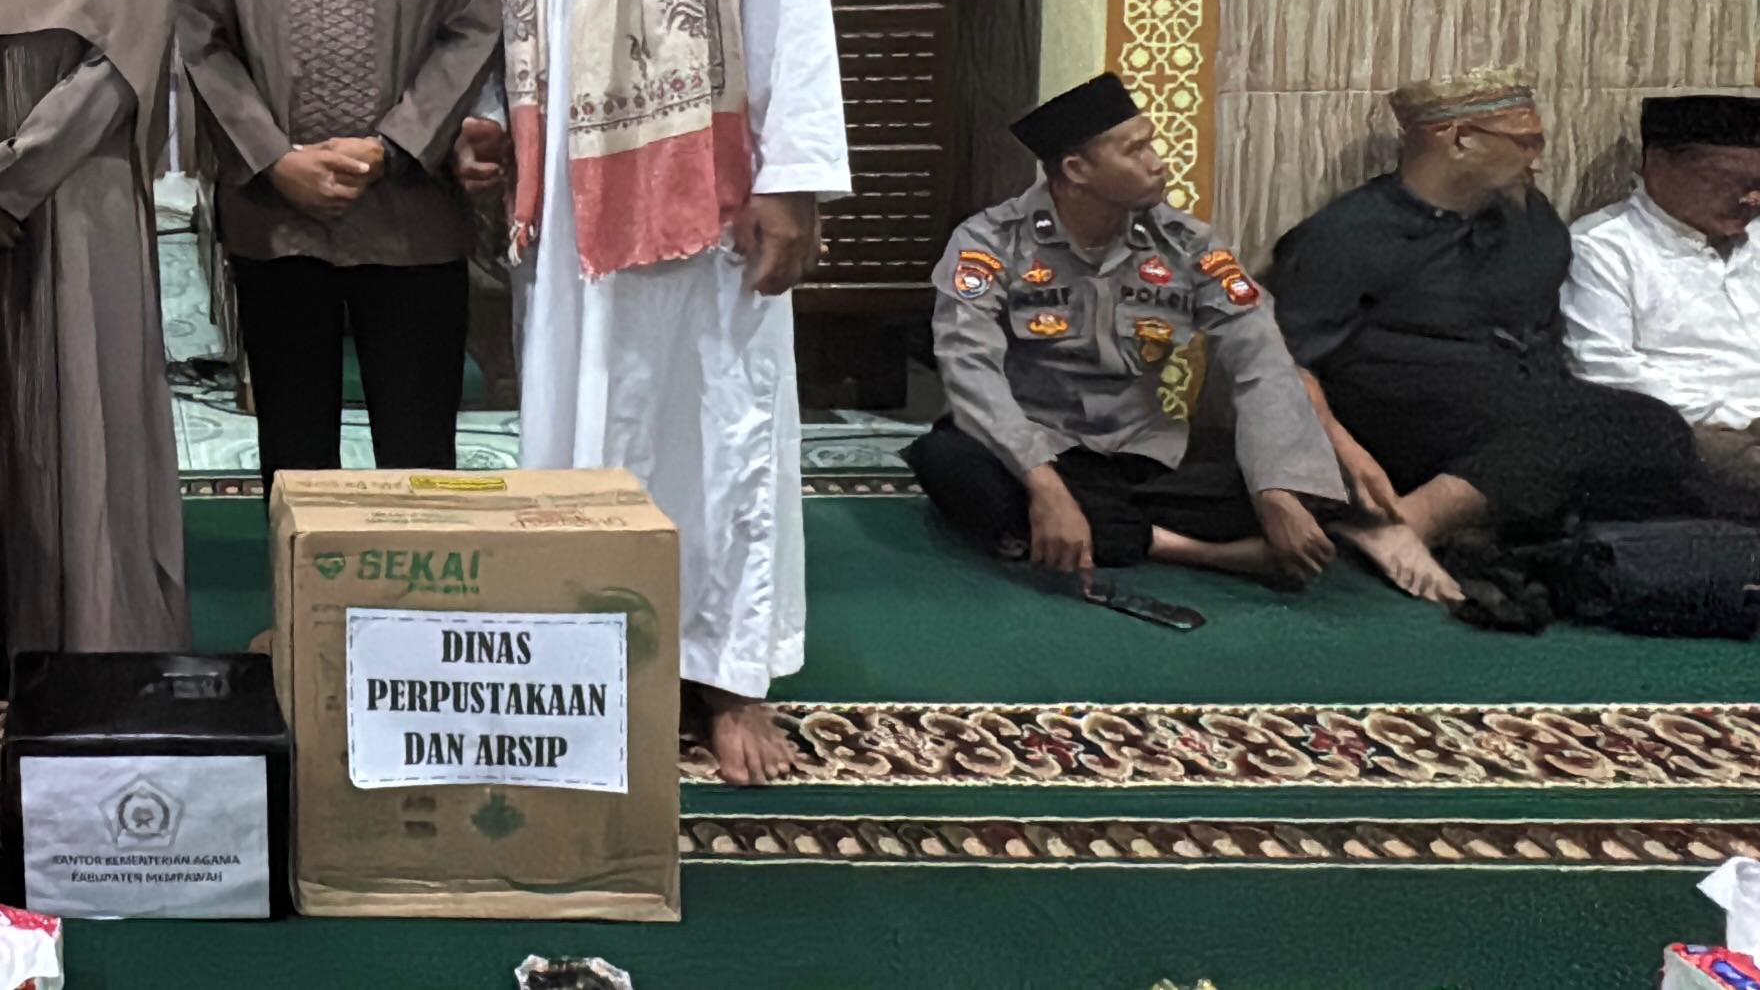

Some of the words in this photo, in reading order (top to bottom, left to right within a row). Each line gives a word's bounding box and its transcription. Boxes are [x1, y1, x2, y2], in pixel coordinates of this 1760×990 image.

[356, 549, 481, 582] SEKAI
[440, 629, 532, 666] DINAS
[366, 677, 608, 718] PERPUSTAKAAN
[403, 731, 466, 766] DAN
[474, 733, 569, 769] ARSIP
[192, 854, 242, 866] AGAMA
